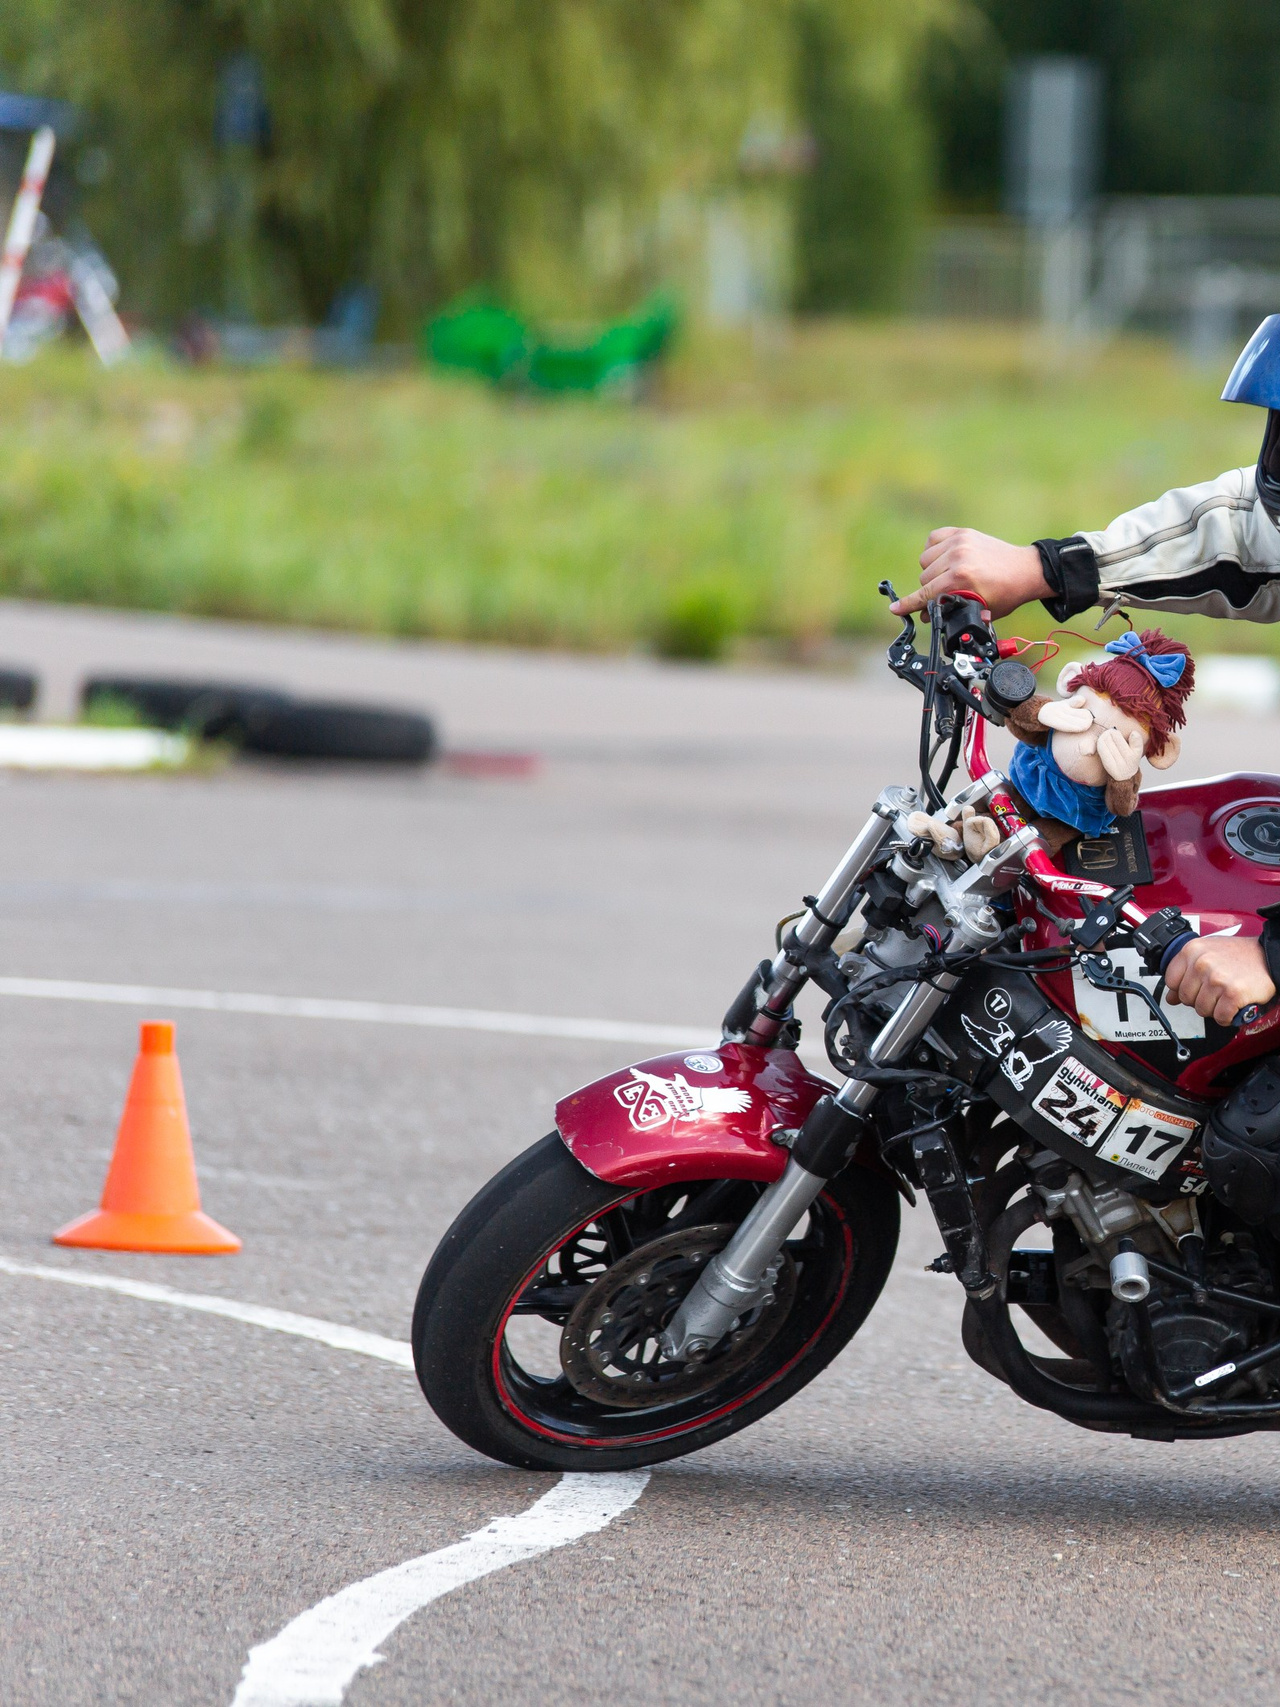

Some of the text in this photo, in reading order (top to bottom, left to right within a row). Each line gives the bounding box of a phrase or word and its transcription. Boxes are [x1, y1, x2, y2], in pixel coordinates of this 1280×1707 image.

[991, 993, 1008, 1013] 17
[1115, 1029, 1168, 1039] Мценск 2023
[1057, 1066, 1120, 1113] gymkhana
[1038, 1080, 1100, 1139] 24
[1125, 1125, 1184, 1162] 17
[1120, 1157, 1158, 1177] Липецк
[1180, 1177, 1209, 1196] 54
